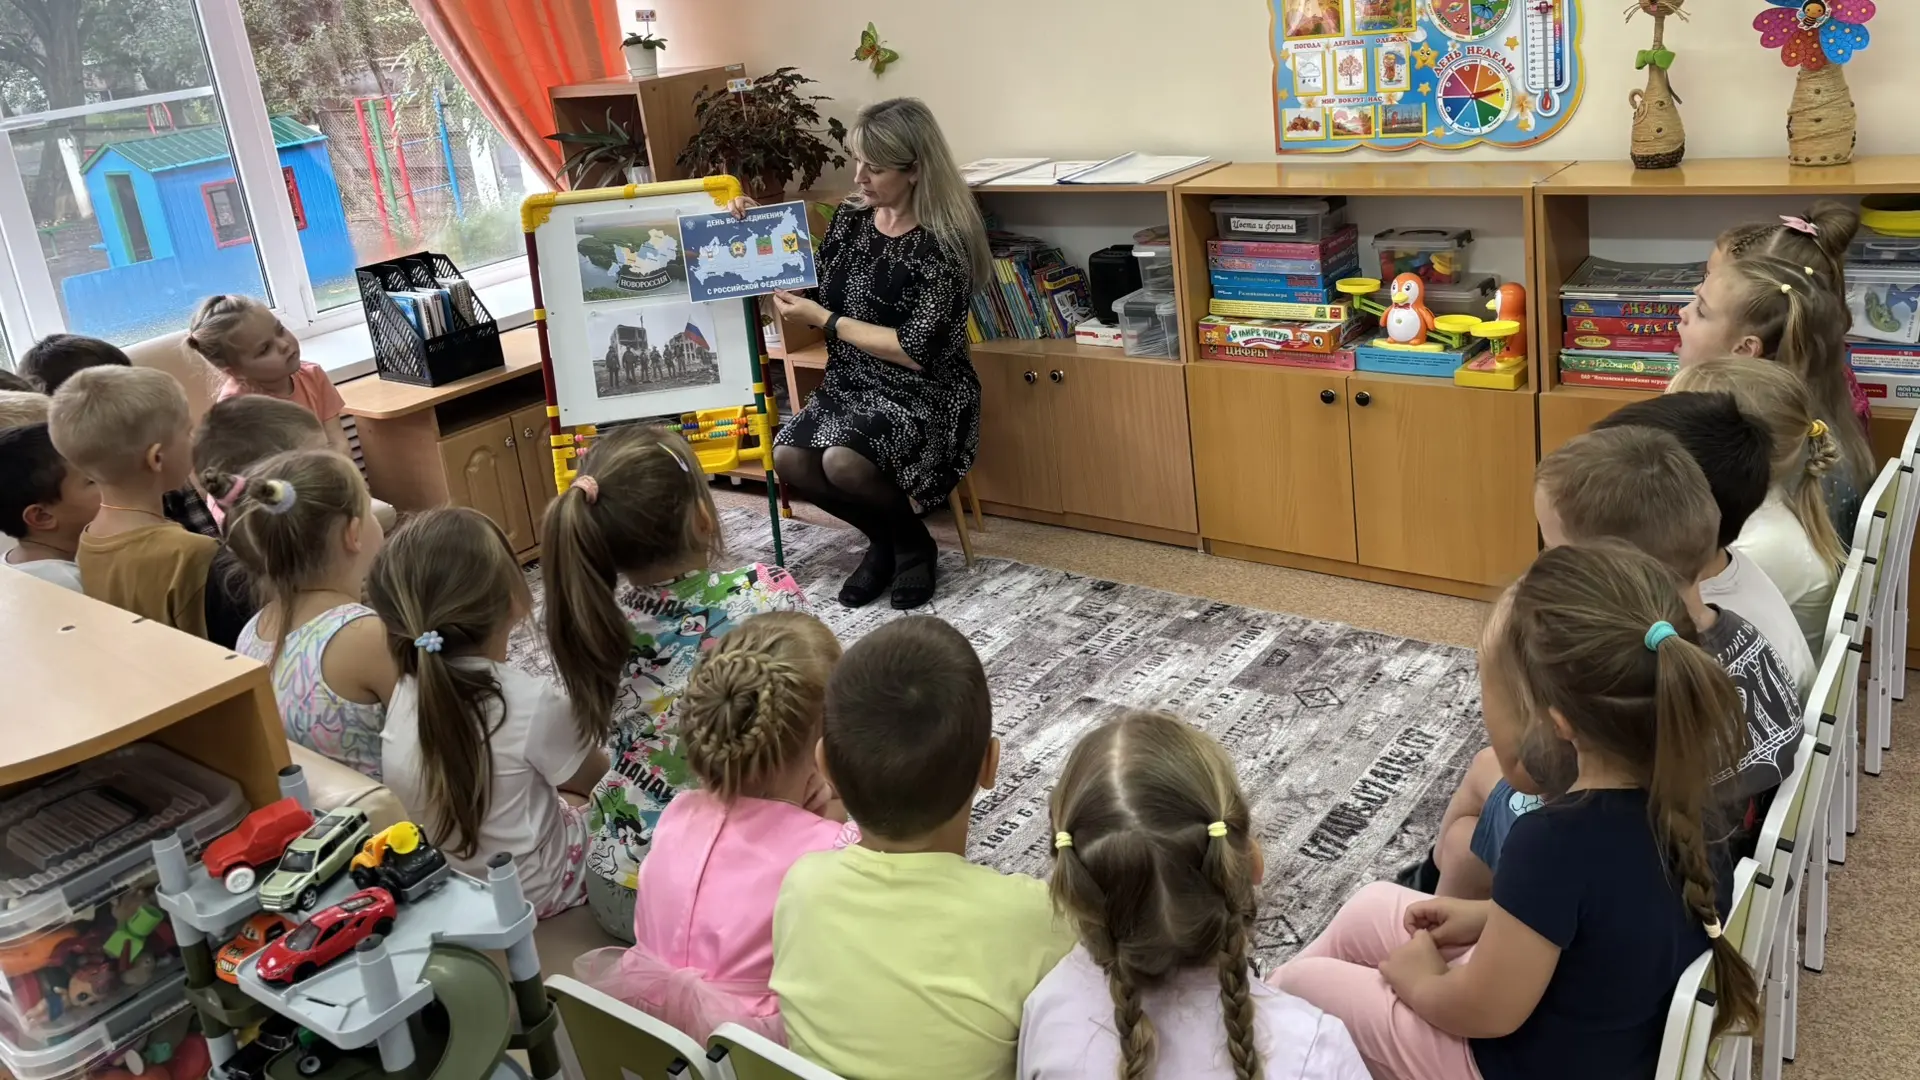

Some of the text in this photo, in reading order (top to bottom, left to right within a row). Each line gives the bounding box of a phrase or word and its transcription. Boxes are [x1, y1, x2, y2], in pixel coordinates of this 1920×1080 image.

[1434, 51, 1462, 76] ДЕНЬ
[1466, 46, 1515, 73] НЕДЕЛИ
[706, 211, 784, 228] ДЕНЬ ВООЕДИНЕНИЯ
[1232, 220, 1257, 229] Цвета
[1265, 221, 1294, 232] формы
[620, 275, 668, 288] НОВОРОССИЯ
[714, 282, 759, 294] РОССИЙСКОЙ
[760, 276, 804, 289] ФЕДЕРАЦИЕЙ
[1621, 302, 1680, 316] АНТОНИМ
[1232, 328, 1289, 340] В МИРЕ ФИГУР
[1225, 346, 1268, 358] ЦИФРЫ
